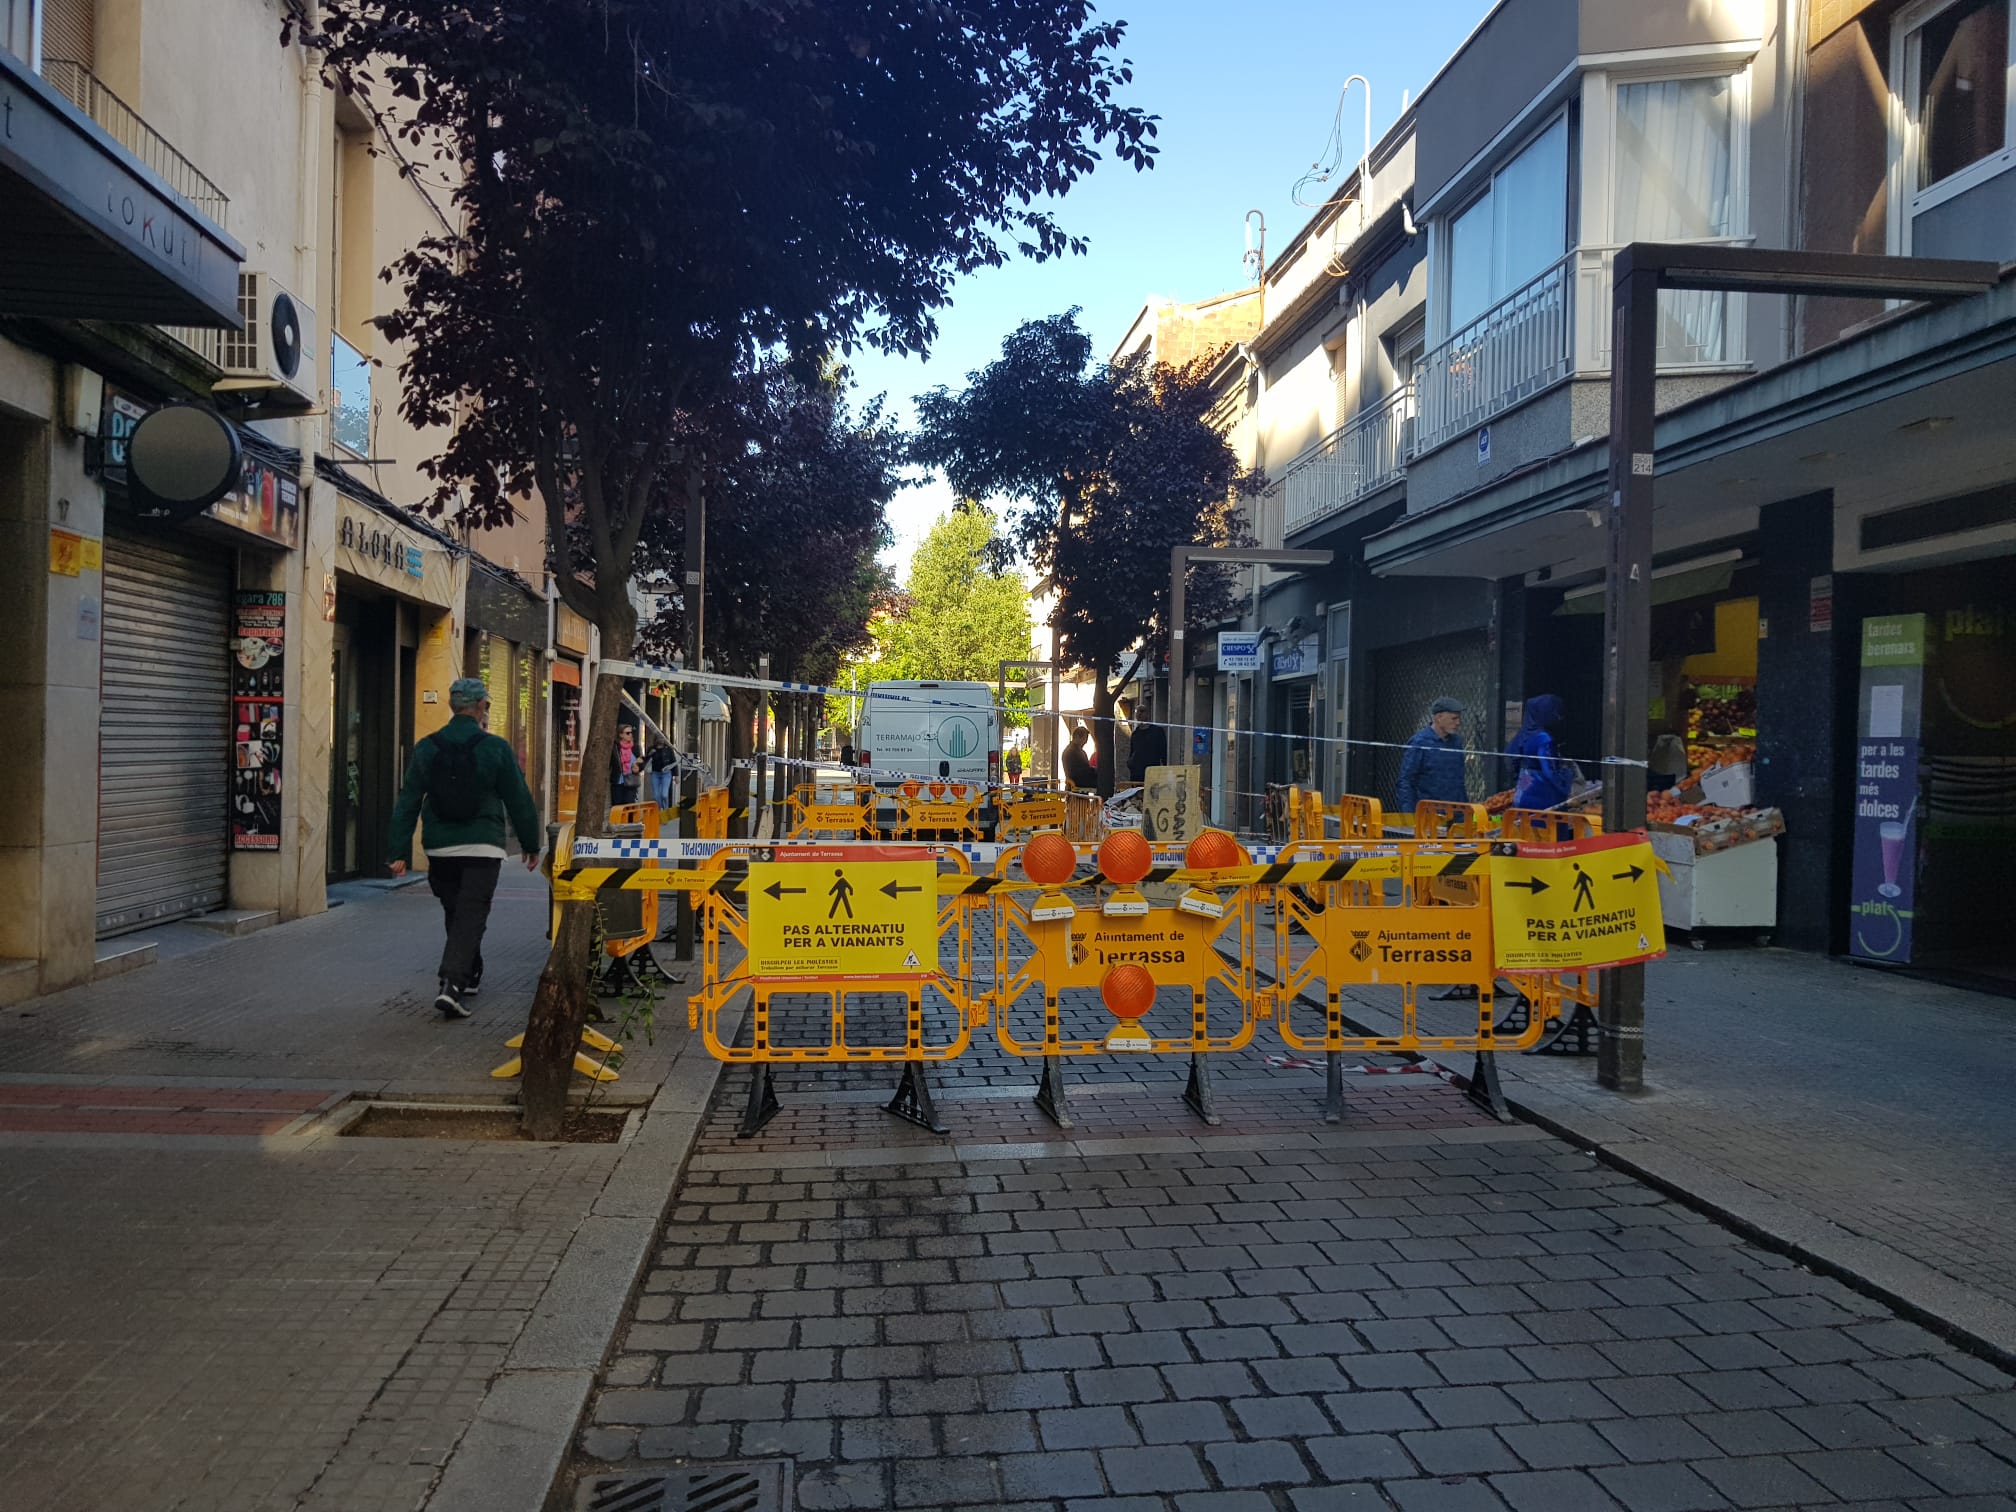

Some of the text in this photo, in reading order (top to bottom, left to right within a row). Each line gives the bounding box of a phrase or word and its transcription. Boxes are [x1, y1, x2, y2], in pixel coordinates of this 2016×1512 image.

[1634, 463, 1652, 473] 214
[341, 515, 404, 571] ALOHA
[266, 592, 284, 606] 786
[1861, 743, 1905, 758] per a les
[1860, 761, 1900, 779] tardes
[1859, 782, 1880, 796] més
[1859, 799, 1900, 818] dolces
[779, 850, 811, 858] Ajuntament
[1861, 899, 1895, 916] plats
[1526, 907, 1636, 930] PAS ALTERNATIU
[783, 923, 905, 935] PAS ALTERNATIU
[1170, 930, 1185, 941] de
[1377, 929, 1472, 943] Ajuntament de
[1527, 920, 1637, 942] PER A VIANANTS
[783, 935, 905, 948] PER A VIANANTS
[1377, 945, 1473, 962] Terrassa
